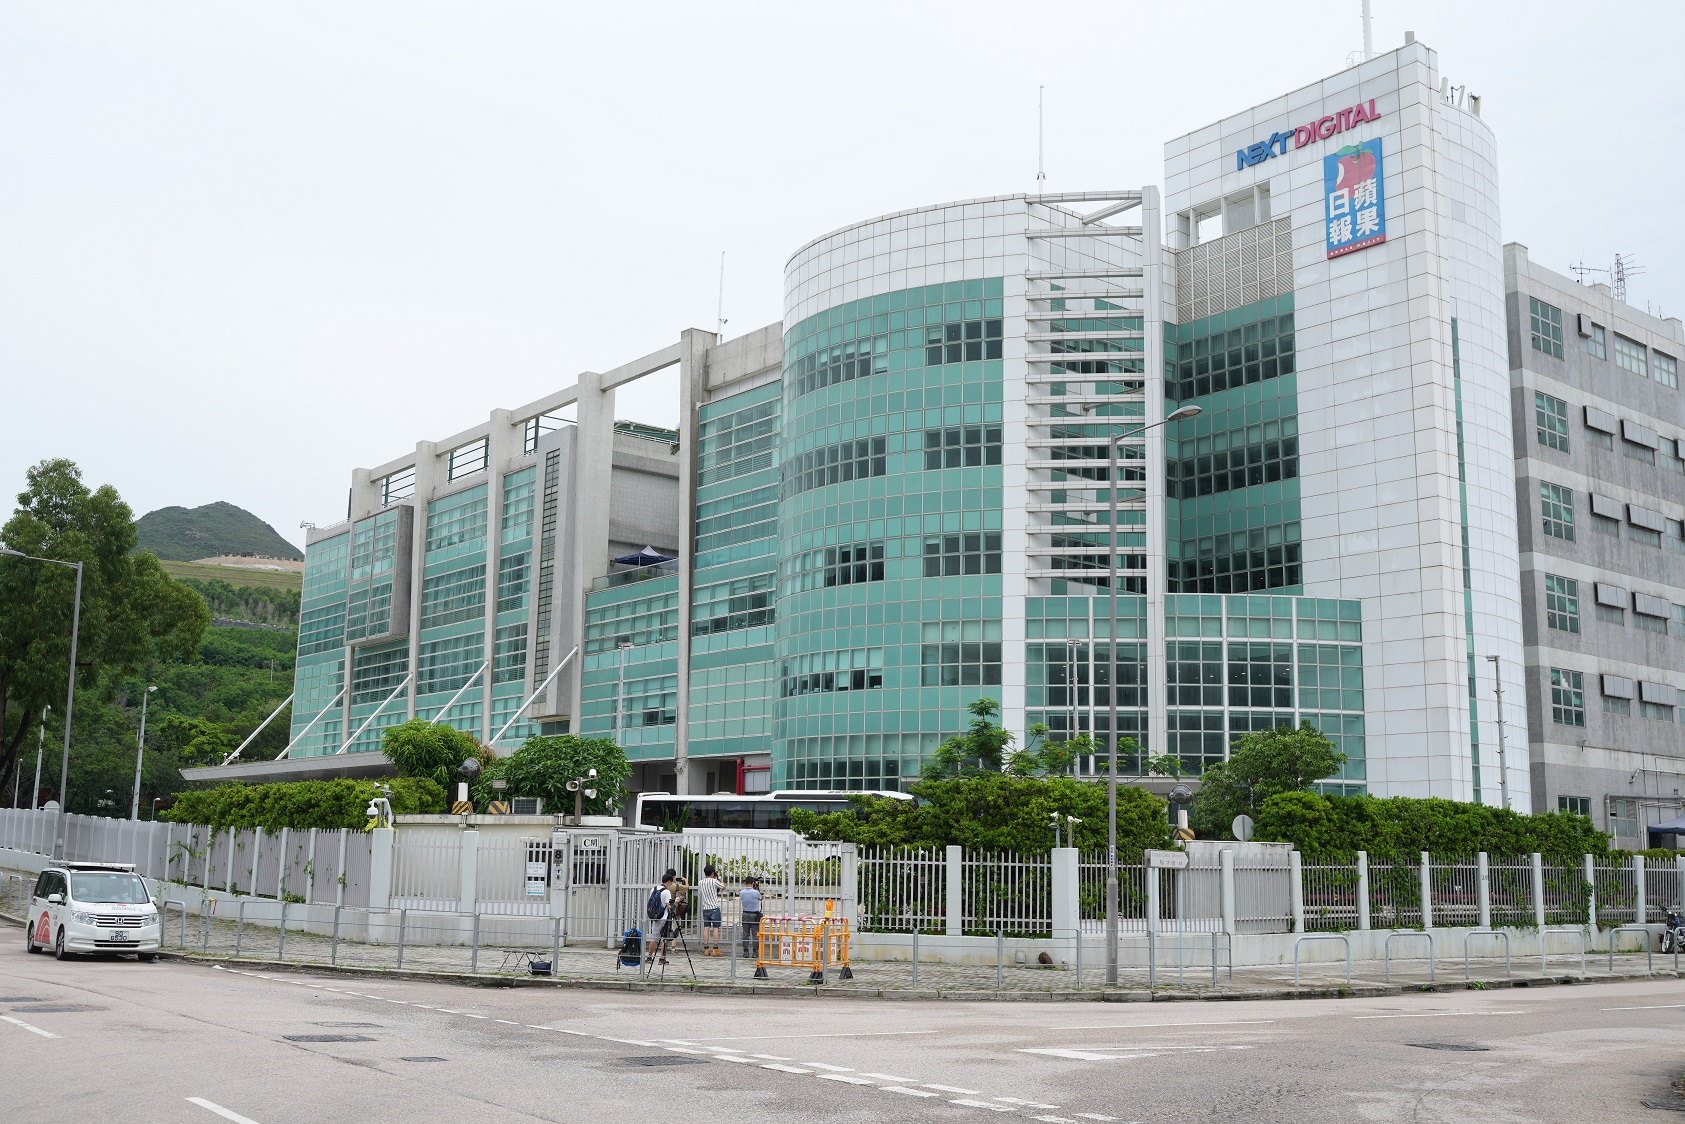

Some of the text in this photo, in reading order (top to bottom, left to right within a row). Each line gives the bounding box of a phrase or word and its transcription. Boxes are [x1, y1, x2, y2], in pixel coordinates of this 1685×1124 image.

[1237, 99, 1381, 170] NEXT DIGITAL
[1329, 187, 1352, 245] 日報
[1353, 177, 1380, 237] 蘋果
[555, 850, 562, 859] 8
